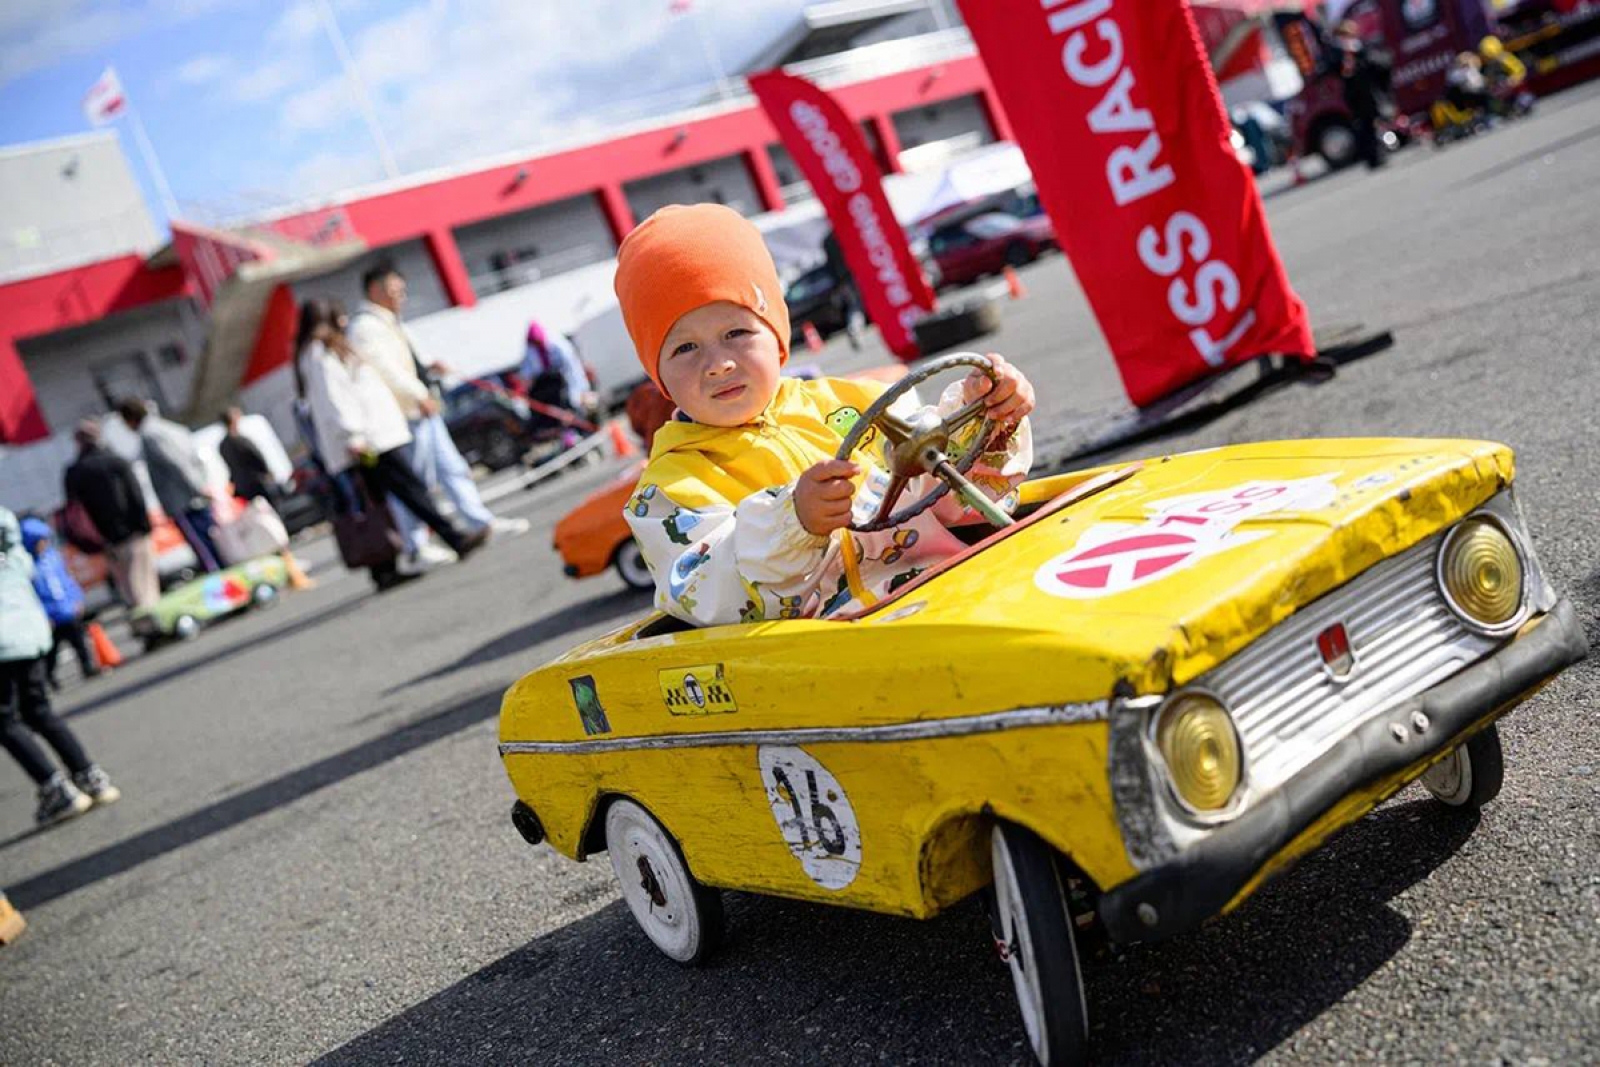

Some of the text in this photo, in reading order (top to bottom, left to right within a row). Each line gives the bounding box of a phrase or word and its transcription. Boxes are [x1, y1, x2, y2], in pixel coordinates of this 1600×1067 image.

[788, 99, 912, 308] RACING GROUP
[1040, 0, 1256, 367] TSS RACI
[772, 766, 846, 855] 16
